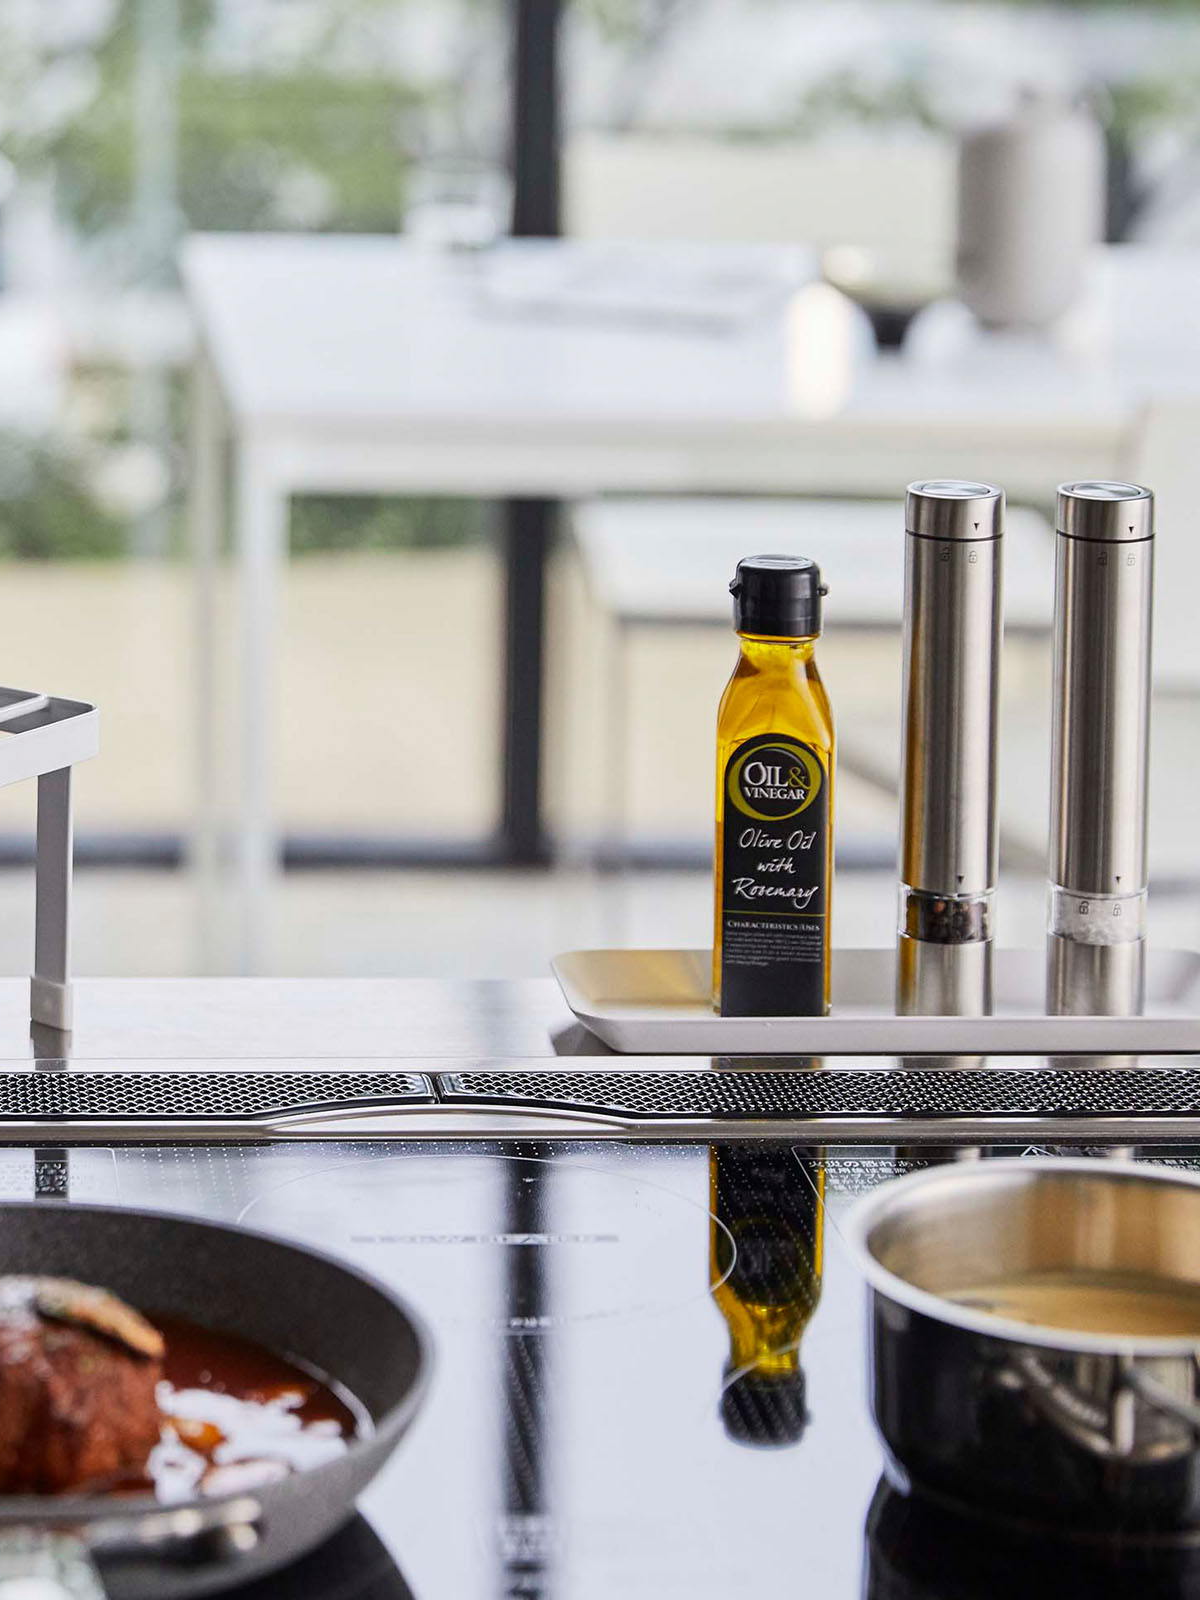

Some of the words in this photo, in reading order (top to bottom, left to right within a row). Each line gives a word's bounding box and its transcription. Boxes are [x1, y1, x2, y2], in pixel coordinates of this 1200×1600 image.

[744, 786, 806, 800] VINEGAR
[739, 827, 783, 849] Olive
[787, 829, 817, 850] Oil
[757, 856, 797, 874] with
[731, 877, 819, 909] Rosemary
